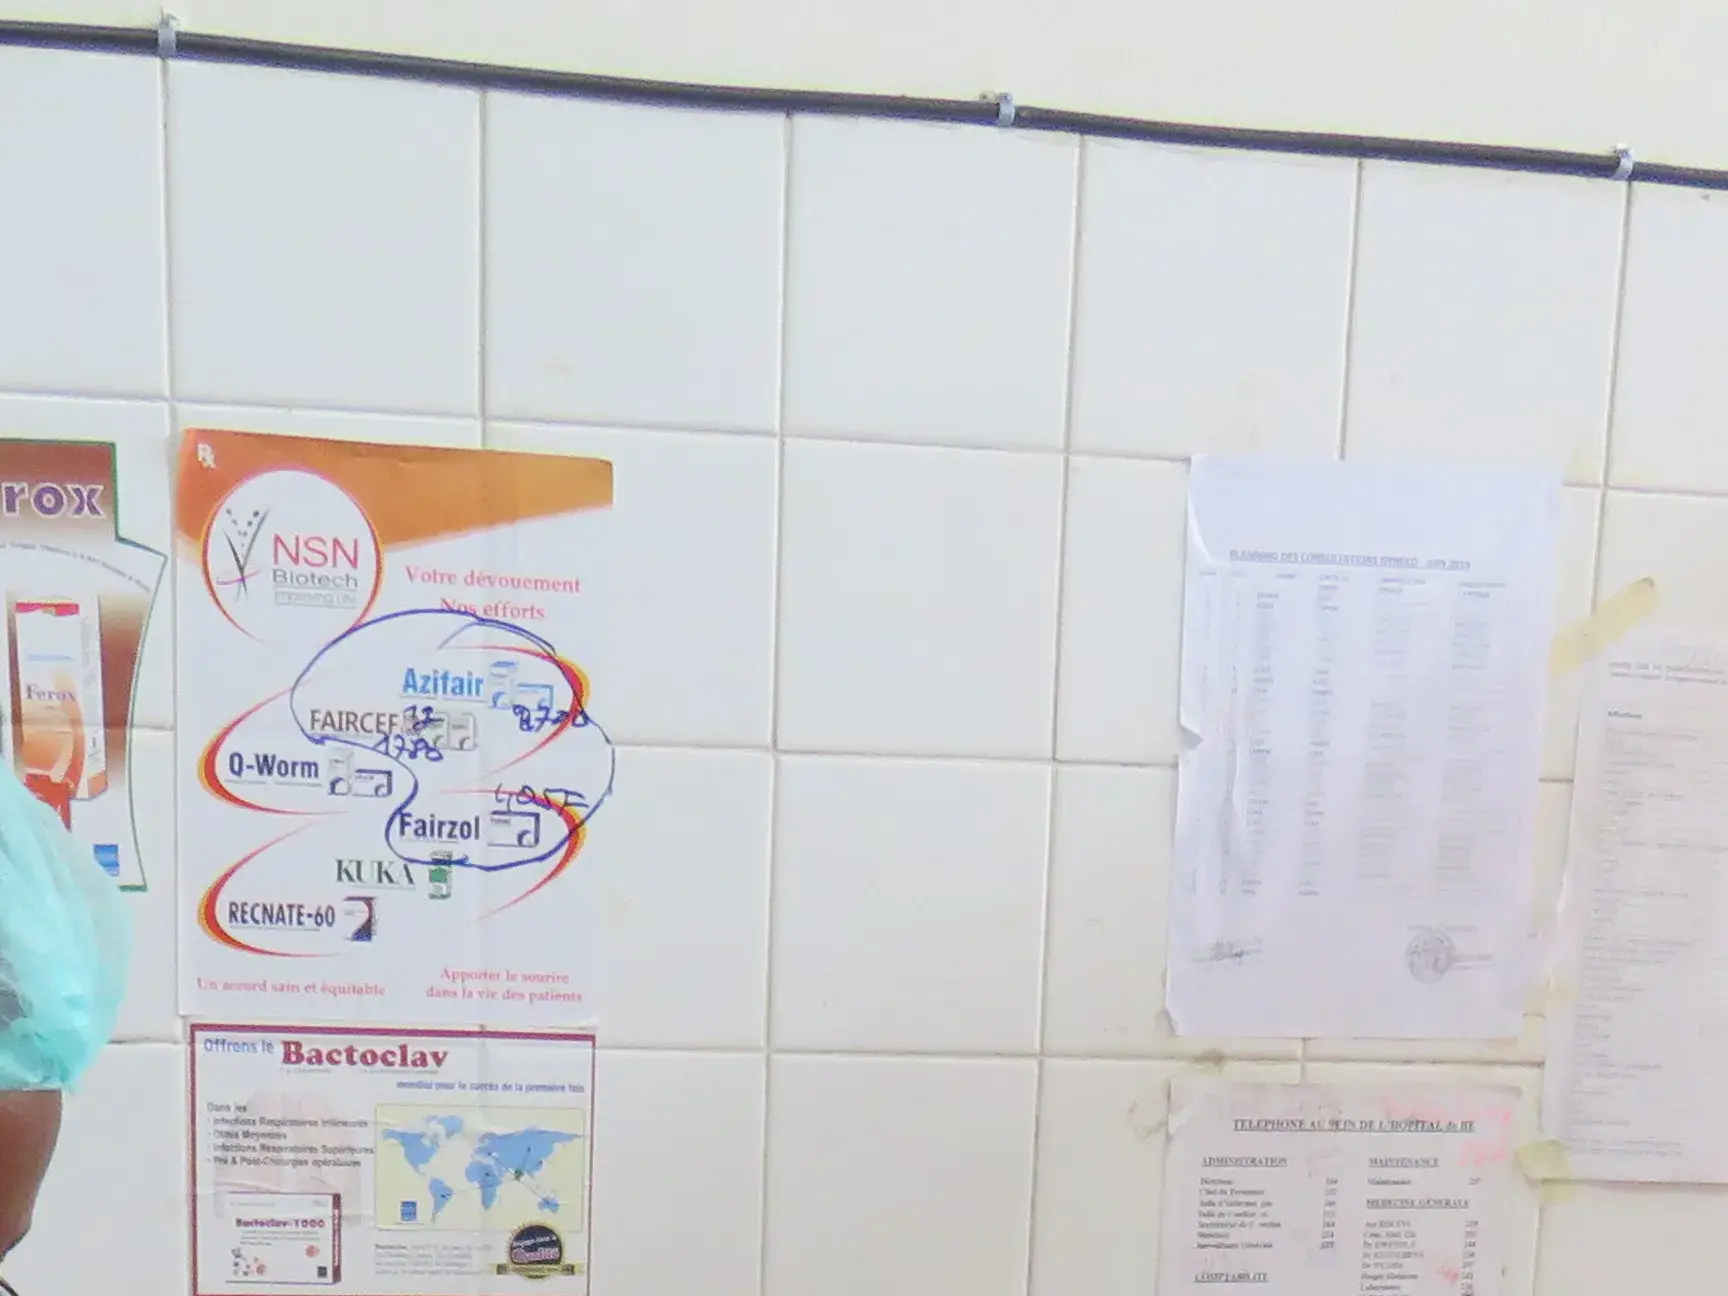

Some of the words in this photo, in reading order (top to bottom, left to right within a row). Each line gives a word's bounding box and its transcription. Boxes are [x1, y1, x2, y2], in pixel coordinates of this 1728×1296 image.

[273, 533, 358, 570] NSN
[272, 568, 358, 588] Biotech
[405, 565, 457, 585] Votre
[463, 570, 581, 594] dévouement
[440, 597, 478, 615] Nos
[483, 600, 546, 620] efforts
[25, 683, 77, 701] Ferox
[402, 667, 485, 699] Azifair
[310, 709, 400, 735] FAIRCEF
[228, 751, 319, 779] Q-Worm
[399, 811, 480, 841] Fairzol
[335, 858, 416, 885] KUKA
[228, 902, 336, 927] RECNATE-60
[223, 979, 267, 992] accord
[272, 980, 300, 993] sain
[304, 983, 317, 994] et
[440, 968, 501, 984] Apporter
[505, 969, 519, 982] le
[425, 985, 458, 998] dans
[462, 987, 474, 999] la
[477, 987, 499, 1000] vie
[503, 988, 525, 1000] des
[528, 989, 582, 1005] patients
[281, 1039, 449, 1069] Bactoclav
[502, 1082, 513, 1092] de
[1232, 1118, 1306, 1132] TELEPHONE
